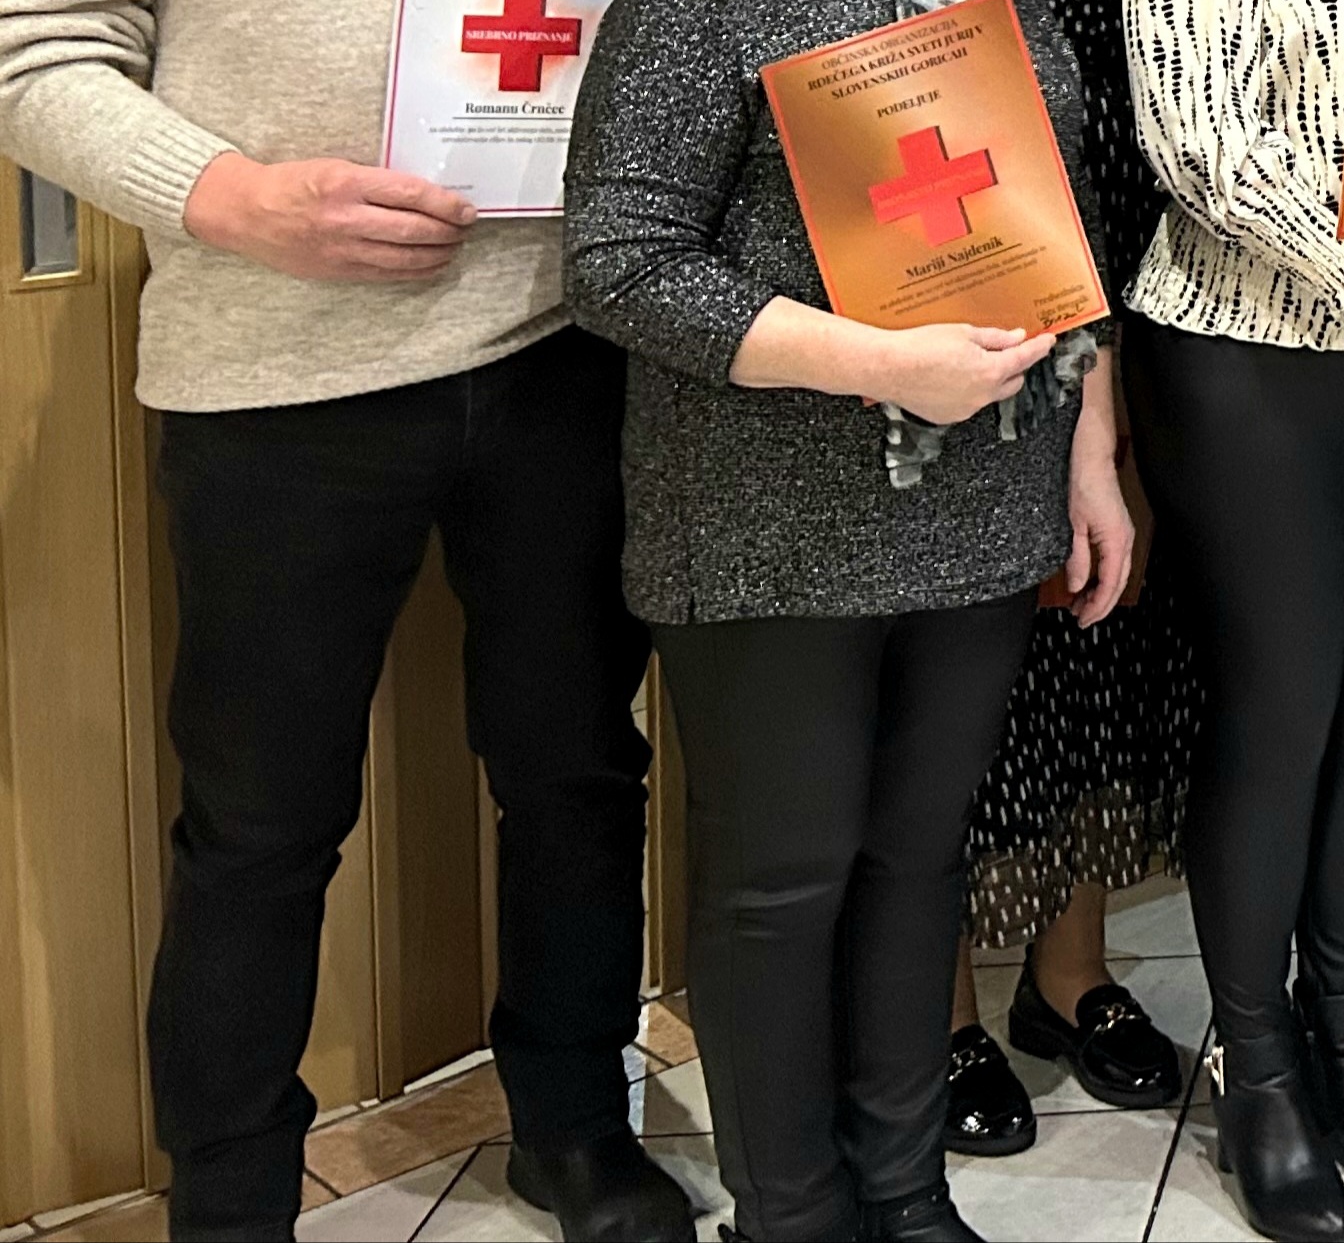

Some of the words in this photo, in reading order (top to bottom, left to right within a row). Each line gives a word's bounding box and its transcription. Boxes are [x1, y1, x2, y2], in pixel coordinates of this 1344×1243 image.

[808, 64, 866, 91] RDEČEGA
[868, 51, 905, 71] KRIŽA
[908, 39, 942, 58] SVETI
[943, 26, 975, 48] JURIJ
[973, 23, 984, 35] V
[831, 67, 908, 100] SLOVENSKIH
[911, 47, 968, 73] GORICAH
[465, 103, 518, 114] Romanu
[877, 90, 941, 118] PODELJUJE
[905, 255, 945, 278] Mariji
[947, 237, 1004, 263] Najdenik
